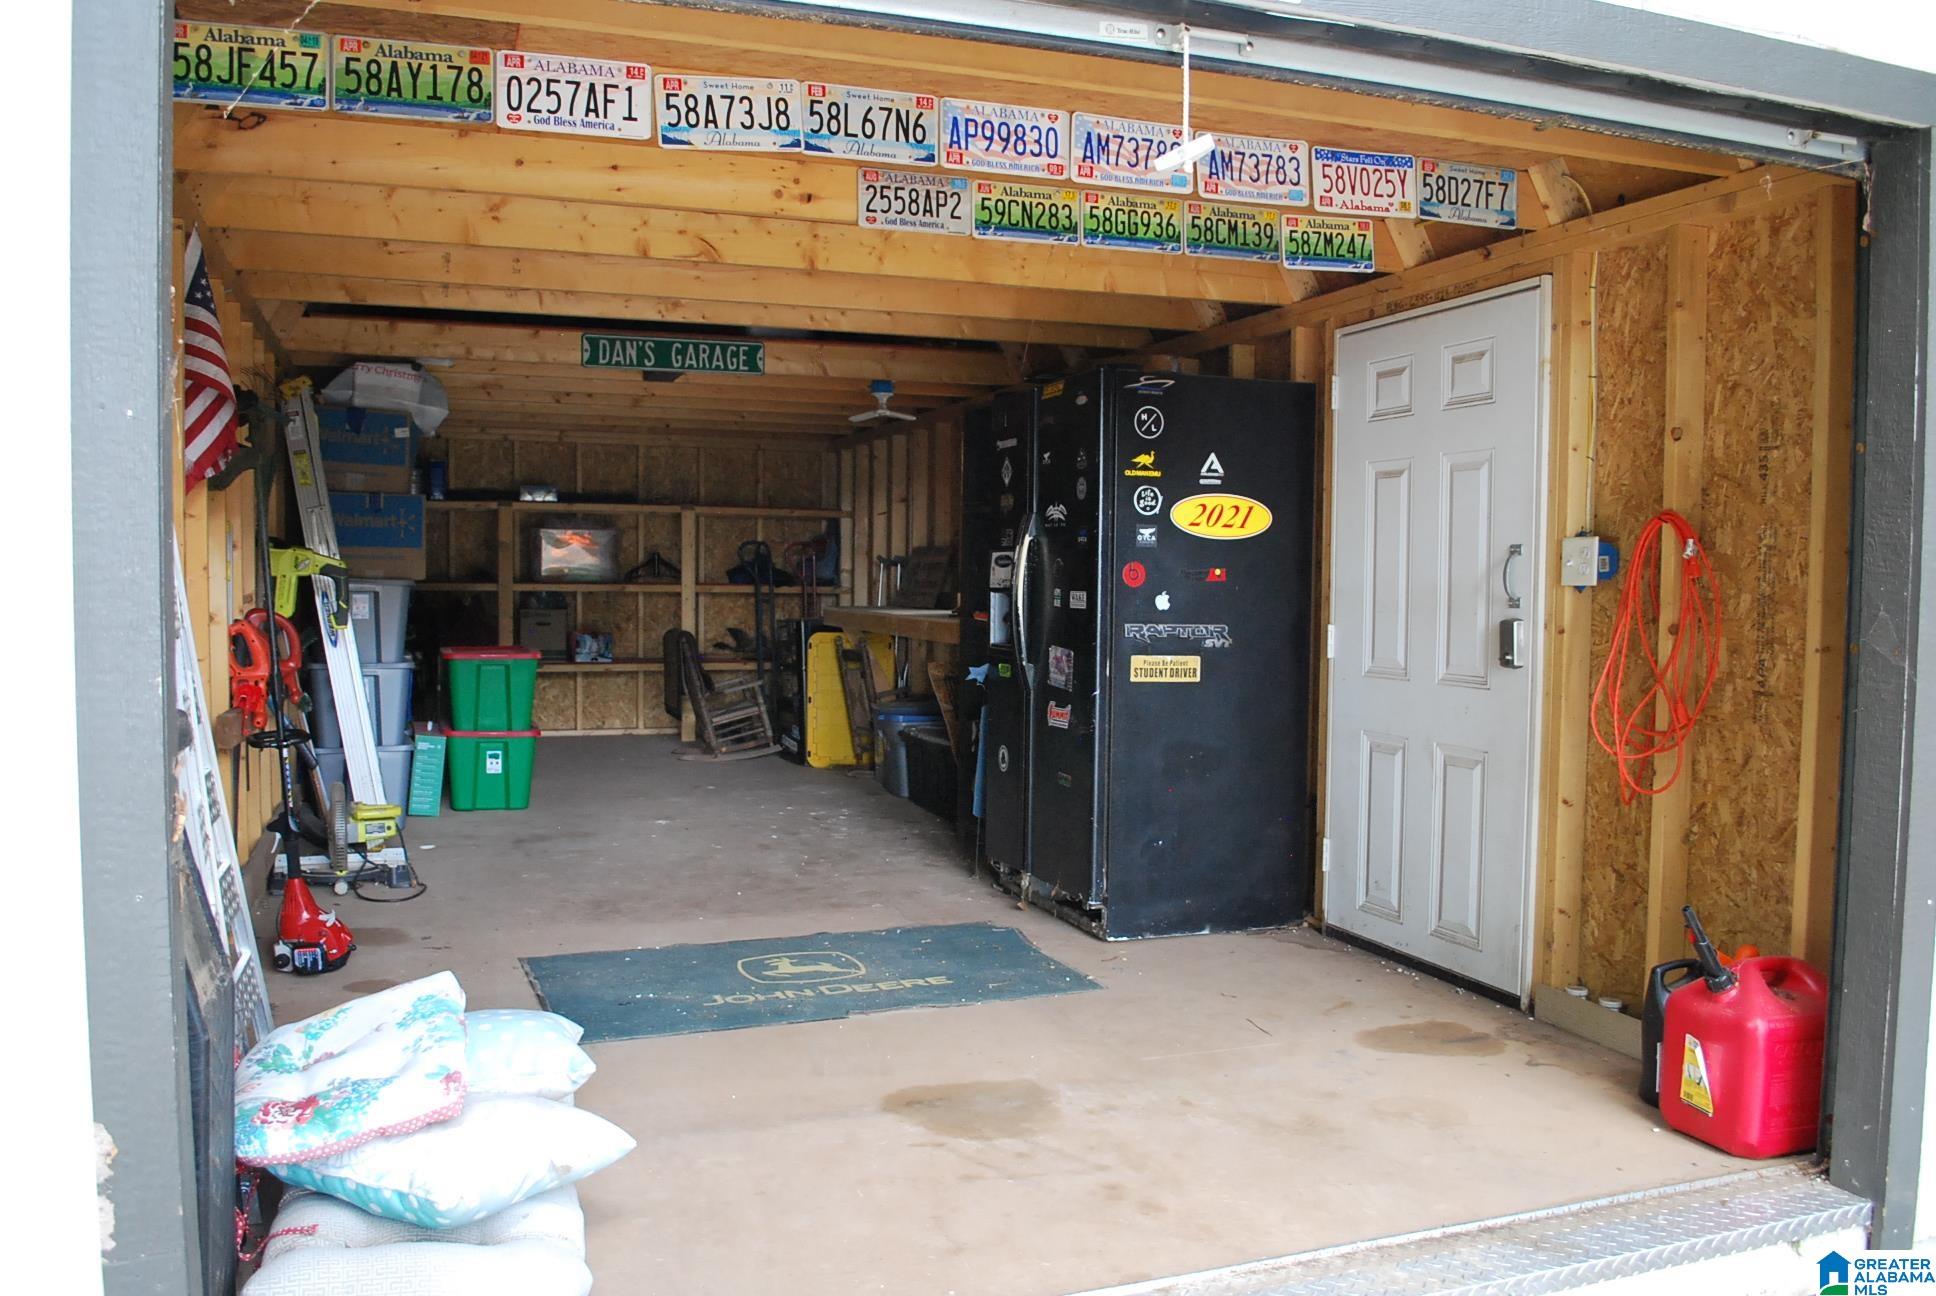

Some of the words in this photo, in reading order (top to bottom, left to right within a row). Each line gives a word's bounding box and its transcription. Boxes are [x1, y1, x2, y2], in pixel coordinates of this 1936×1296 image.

[203, 27, 286, 48] Alabama
[375, 43, 454, 63] Alabama
[174, 42, 319, 90] 58JF457
[507, 56, 522, 68] APR
[534, 60, 615, 78] ALABAMA
[344, 56, 484, 103] 58AY178
[665, 79, 680, 91] APR
[703, 81, 728, 90] Sweet
[731, 83, 755, 91] Home
[506, 75, 639, 122] 0257AF1
[846, 91, 871, 101] Sweet
[873, 93, 895, 103] Home
[665, 93, 791, 131] 58A73J8
[972, 105, 1040, 122] ALABAMA
[534, 114, 551, 126] God
[554, 117, 577, 128] Bless
[580, 118, 615, 131] America
[809, 99, 927, 144] 58L67N6
[1103, 120, 1164, 137] ALABAMA
[704, 131, 761, 147] Alabama
[949, 116, 1058, 159] AP99830
[1224, 137, 1282, 153] ALABAMA
[842, 140, 897, 159] Alabama
[971, 158, 985, 167] GOD
[987, 160, 1008, 170] BLESS
[1208, 148, 1300, 187] AM73783
[1341, 153, 1359, 164] Stars
[1360, 155, 1373, 165] Fell
[1374, 156, 1386, 166] On
[1079, 166, 1092, 177] APR
[885, 173, 945, 188] ALABAMA
[1000, 186, 1053, 200] Alabama
[865, 184, 962, 220] 2558AP2
[1107, 196, 1157, 210] Alabama
[1339, 200, 1390, 213] Alabama
[981, 197, 1073, 231] 59CN283
[1089, 205, 1176, 239] 58GG936
[1209, 206, 1256, 221] Alabama
[1448, 206, 1488, 224] Alabama
[885, 216, 898, 226] God
[899, 218, 917, 228] Bless
[918, 219, 945, 230] America
[1305, 219, 1351, 231] Alabama
[1191, 215, 1274, 249] 58CM139
[1289, 230, 1367, 259] 58ZM247
[599, 339, 655, 366] DAN'S
[671, 342, 749, 371] GARAGE
[1188, 504, 1254, 529] 2021
[1124, 623, 1231, 642] RAPTOR
[1143, 659, 1160, 667] Please
[1169, 659, 1188, 667] Patient
[1133, 667, 1168, 678] STUDENT
[1169, 667, 1198, 678] DRIVER
[703, 987, 816, 1006] JOHN
[818, 975, 954, 996] DEERE
